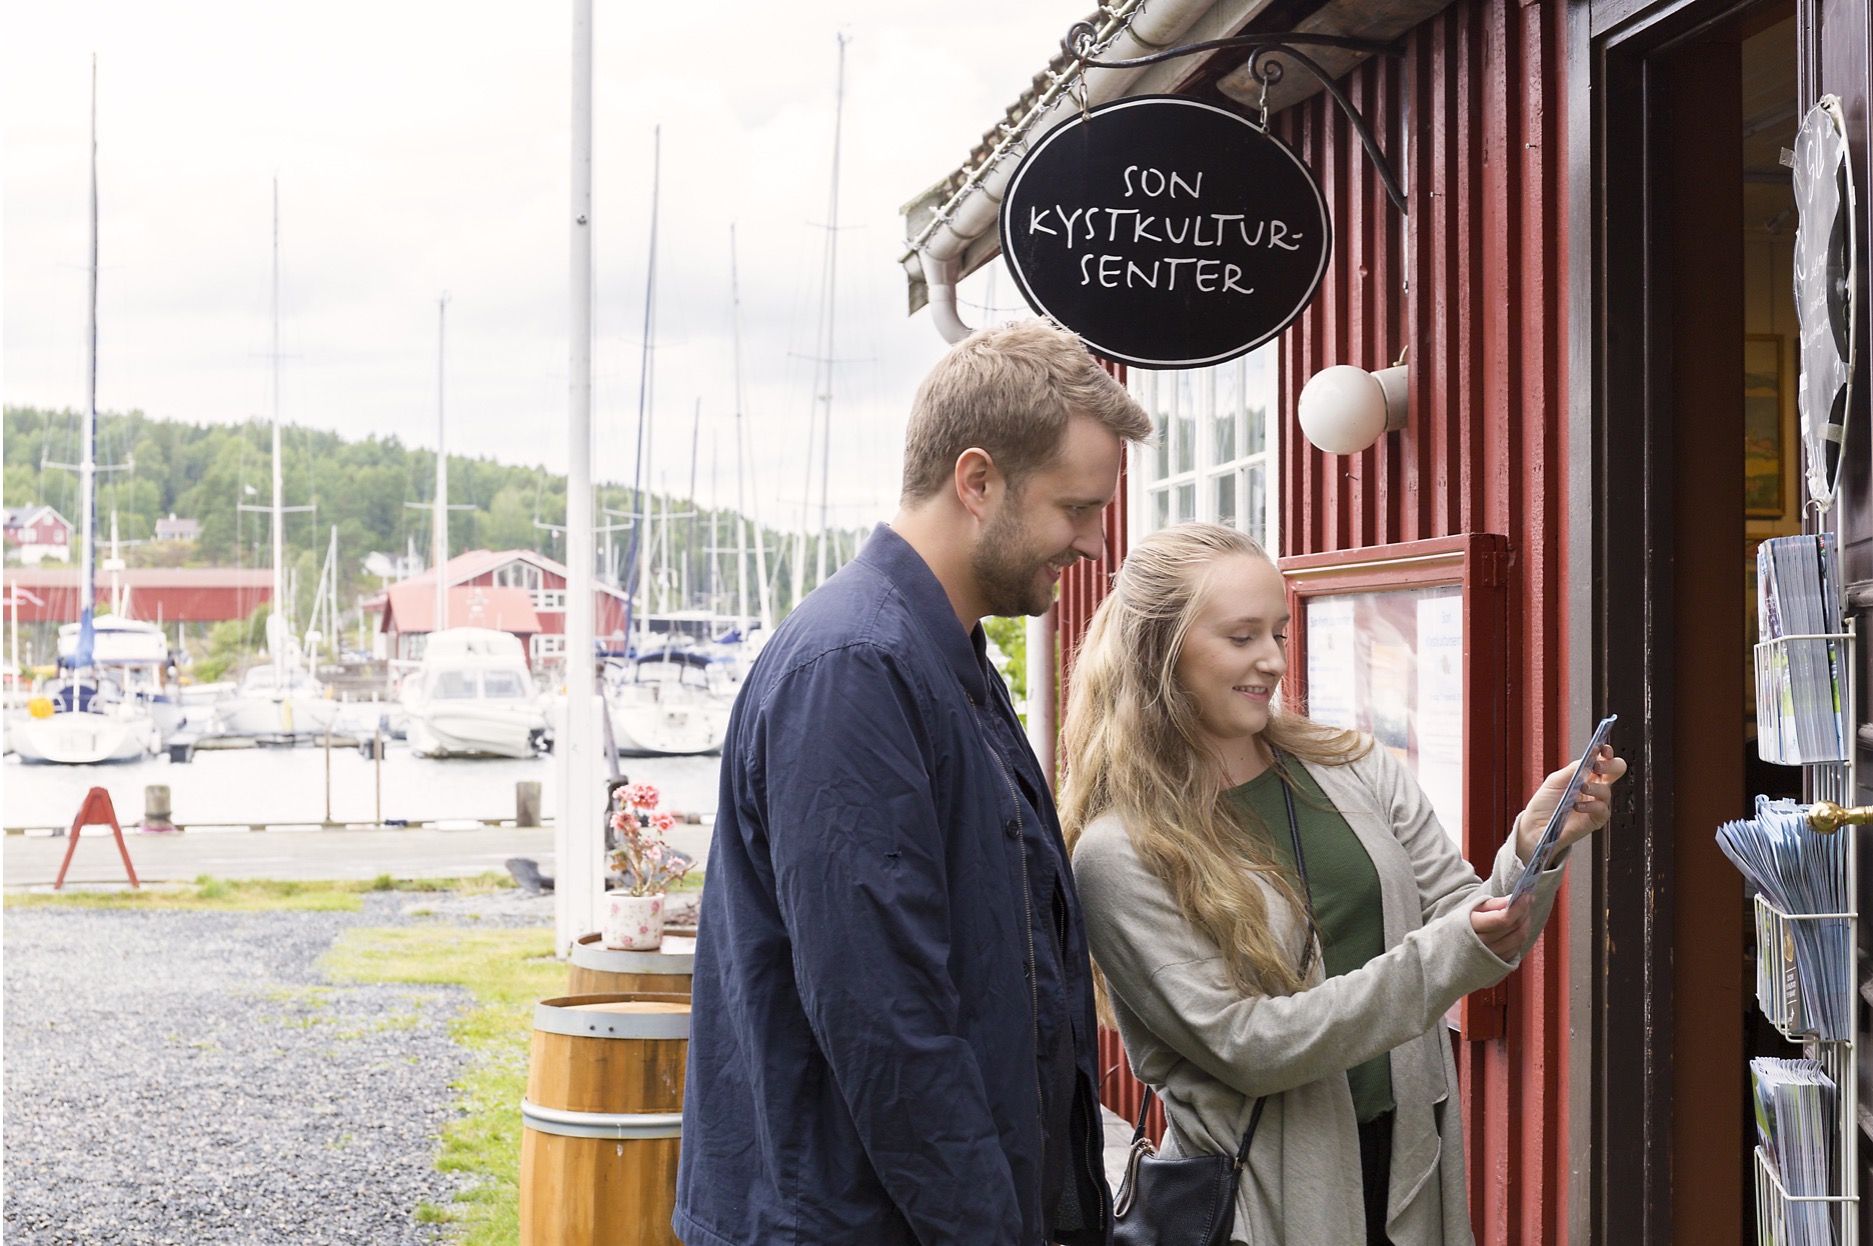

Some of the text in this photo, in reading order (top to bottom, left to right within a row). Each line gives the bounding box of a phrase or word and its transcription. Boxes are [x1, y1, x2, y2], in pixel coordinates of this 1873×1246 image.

[1124, 165, 1203, 199] SON
[1028, 204, 1304, 251] KYSTKULTUR-
[1080, 253, 1255, 295] SENTER
